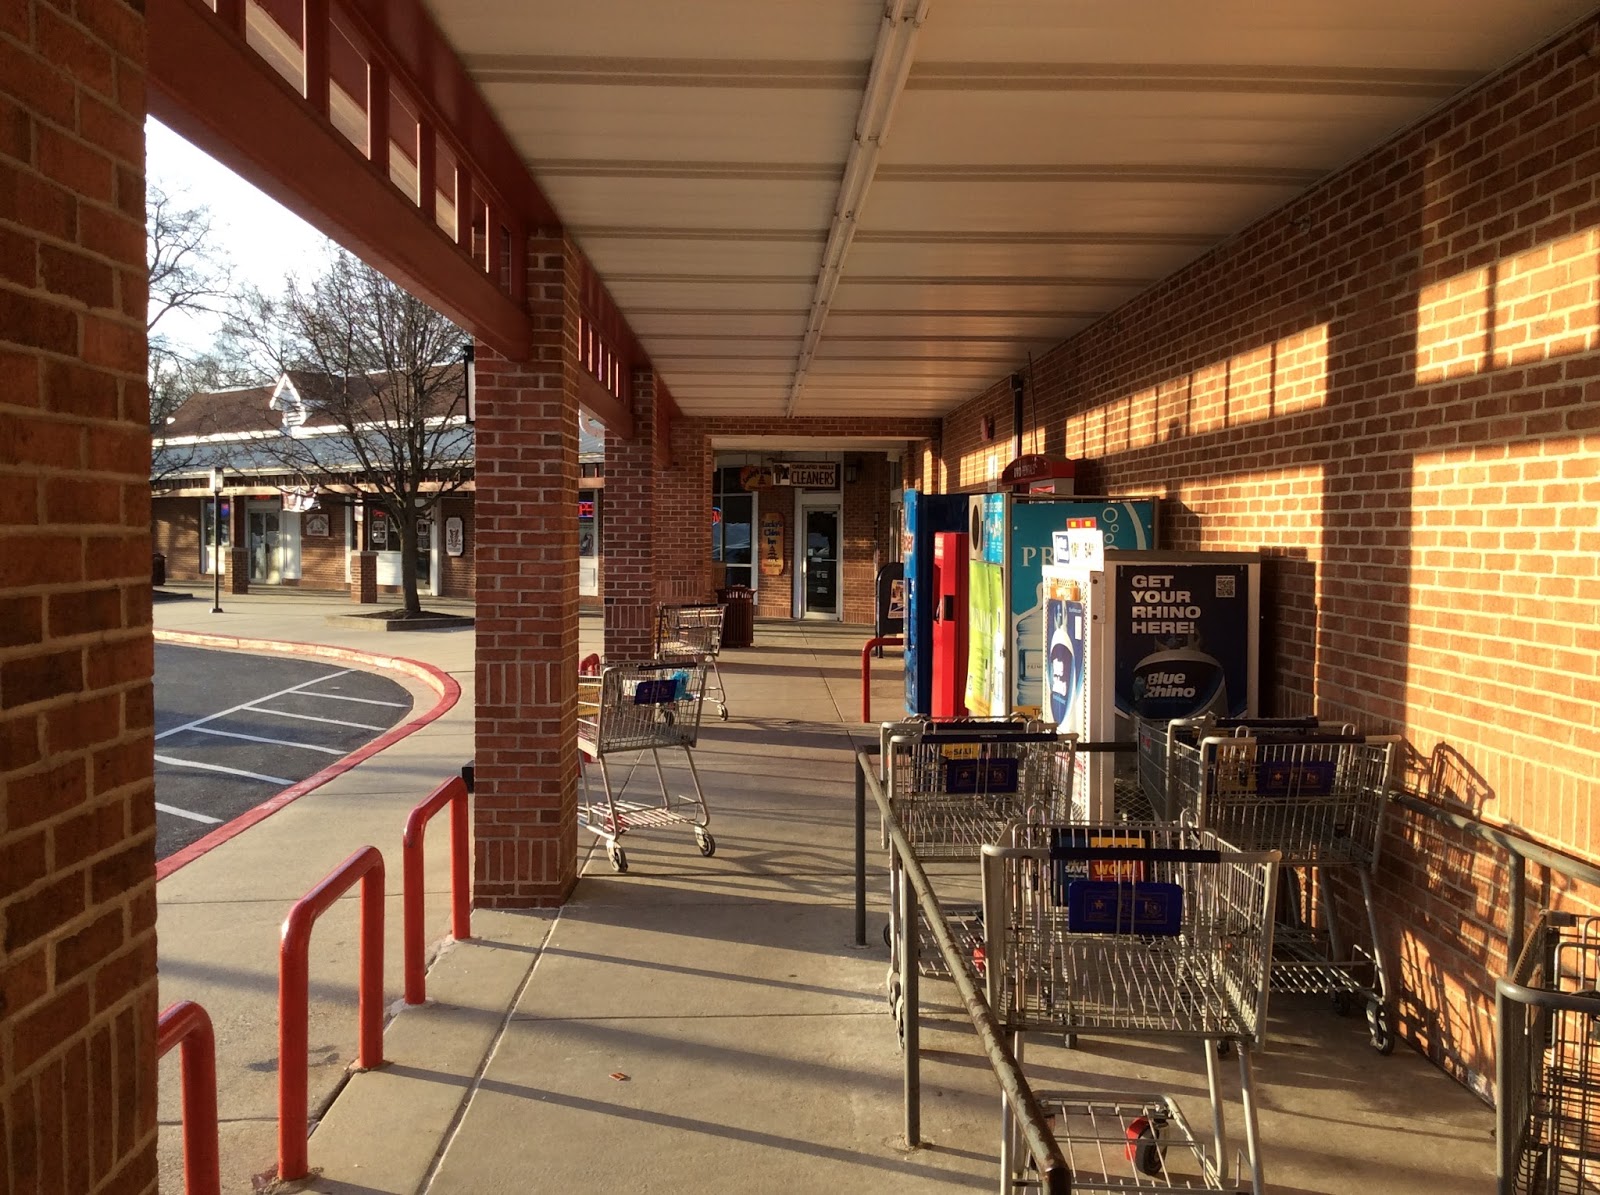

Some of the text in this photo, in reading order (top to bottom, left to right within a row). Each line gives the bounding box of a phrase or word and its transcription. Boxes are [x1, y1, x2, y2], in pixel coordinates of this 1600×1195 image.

[791, 470, 835, 486] CLEANERS
[1131, 575, 1174, 588] GET
[1131, 590, 1191, 604] YOUR
[1131, 606, 1202, 619] RHINO
[1131, 621, 1195, 634] HERE!
[1147, 671, 1186, 686] Blue
[1144, 685, 1197, 698] Rhino
[1065, 865, 1088, 874] SAVE
